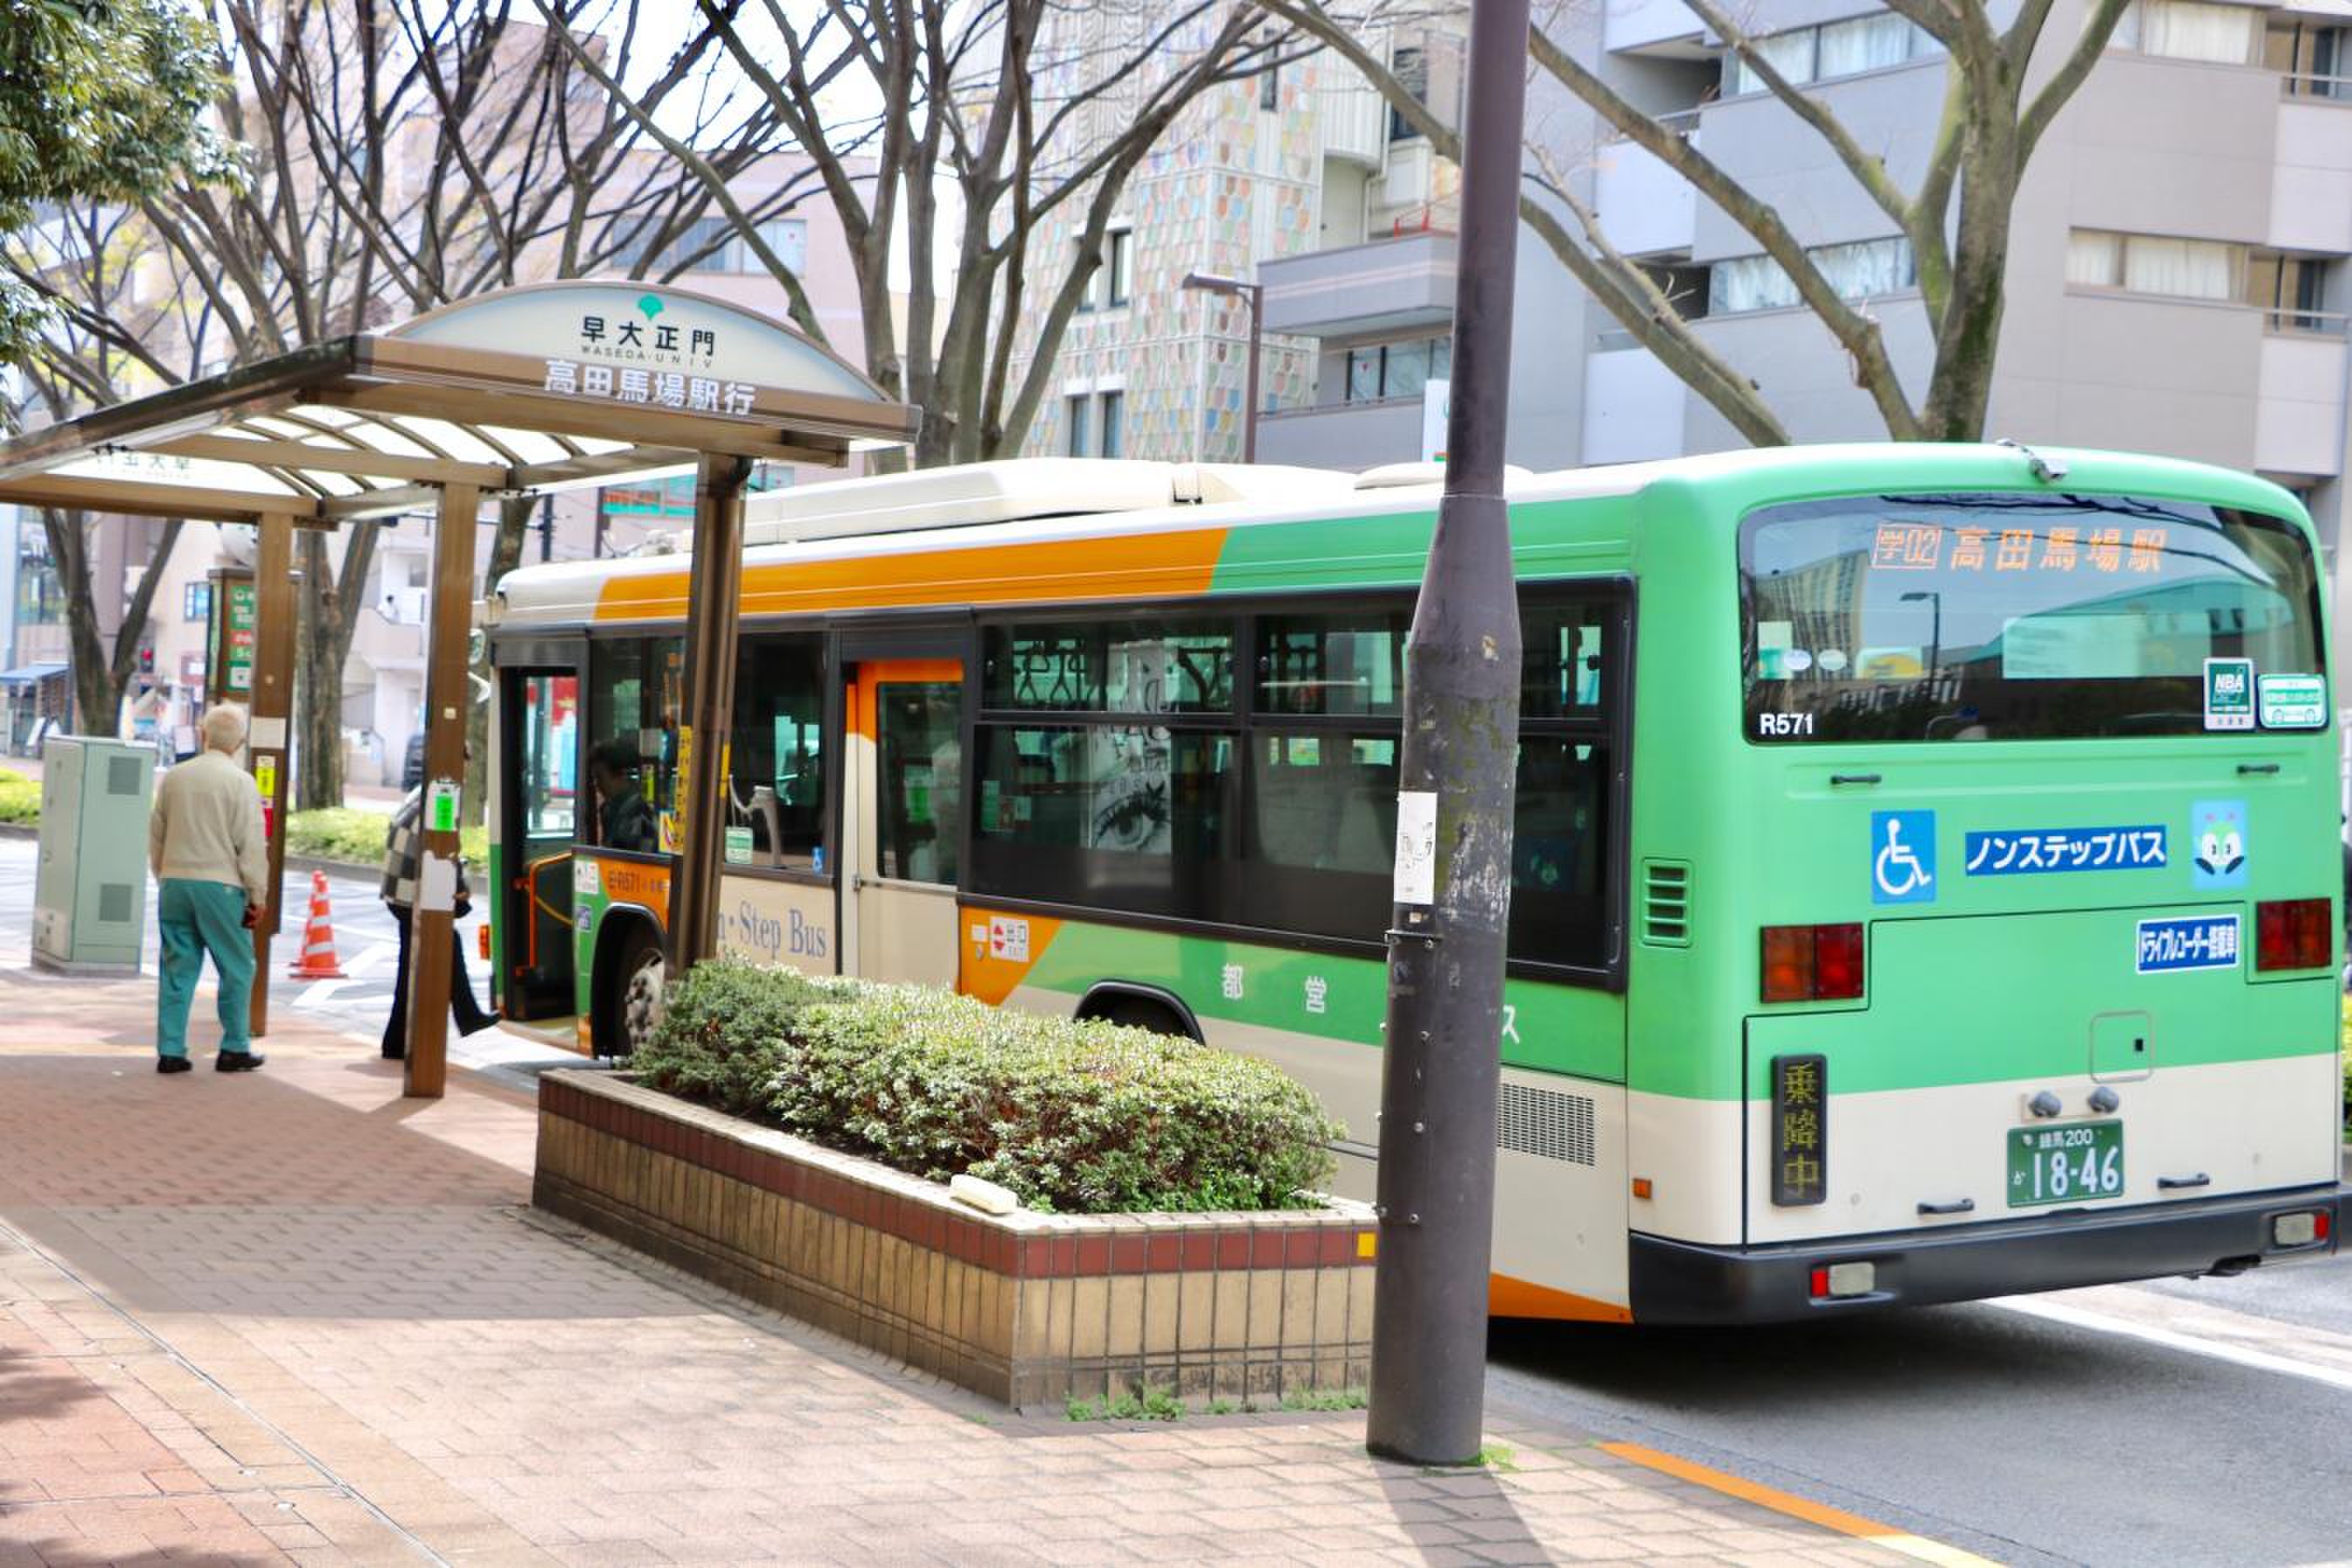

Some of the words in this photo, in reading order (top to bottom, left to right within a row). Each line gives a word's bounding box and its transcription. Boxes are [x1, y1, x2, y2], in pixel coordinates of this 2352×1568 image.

[581, 316, 715, 356] 早大正門
[544, 360, 756, 416] 高田馬場駅行
[1951, 528, 2166, 571] 高田馬場駅
[2215, 673, 2245, 693] NBA
[1760, 713, 1813, 734] R571
[1966, 831, 2166, 871] ノンステップバス
[789, 909, 827, 958] Bus
[2065, 1128, 2093, 1147] 200
[2034, 1146, 2119, 1200] 18-46
